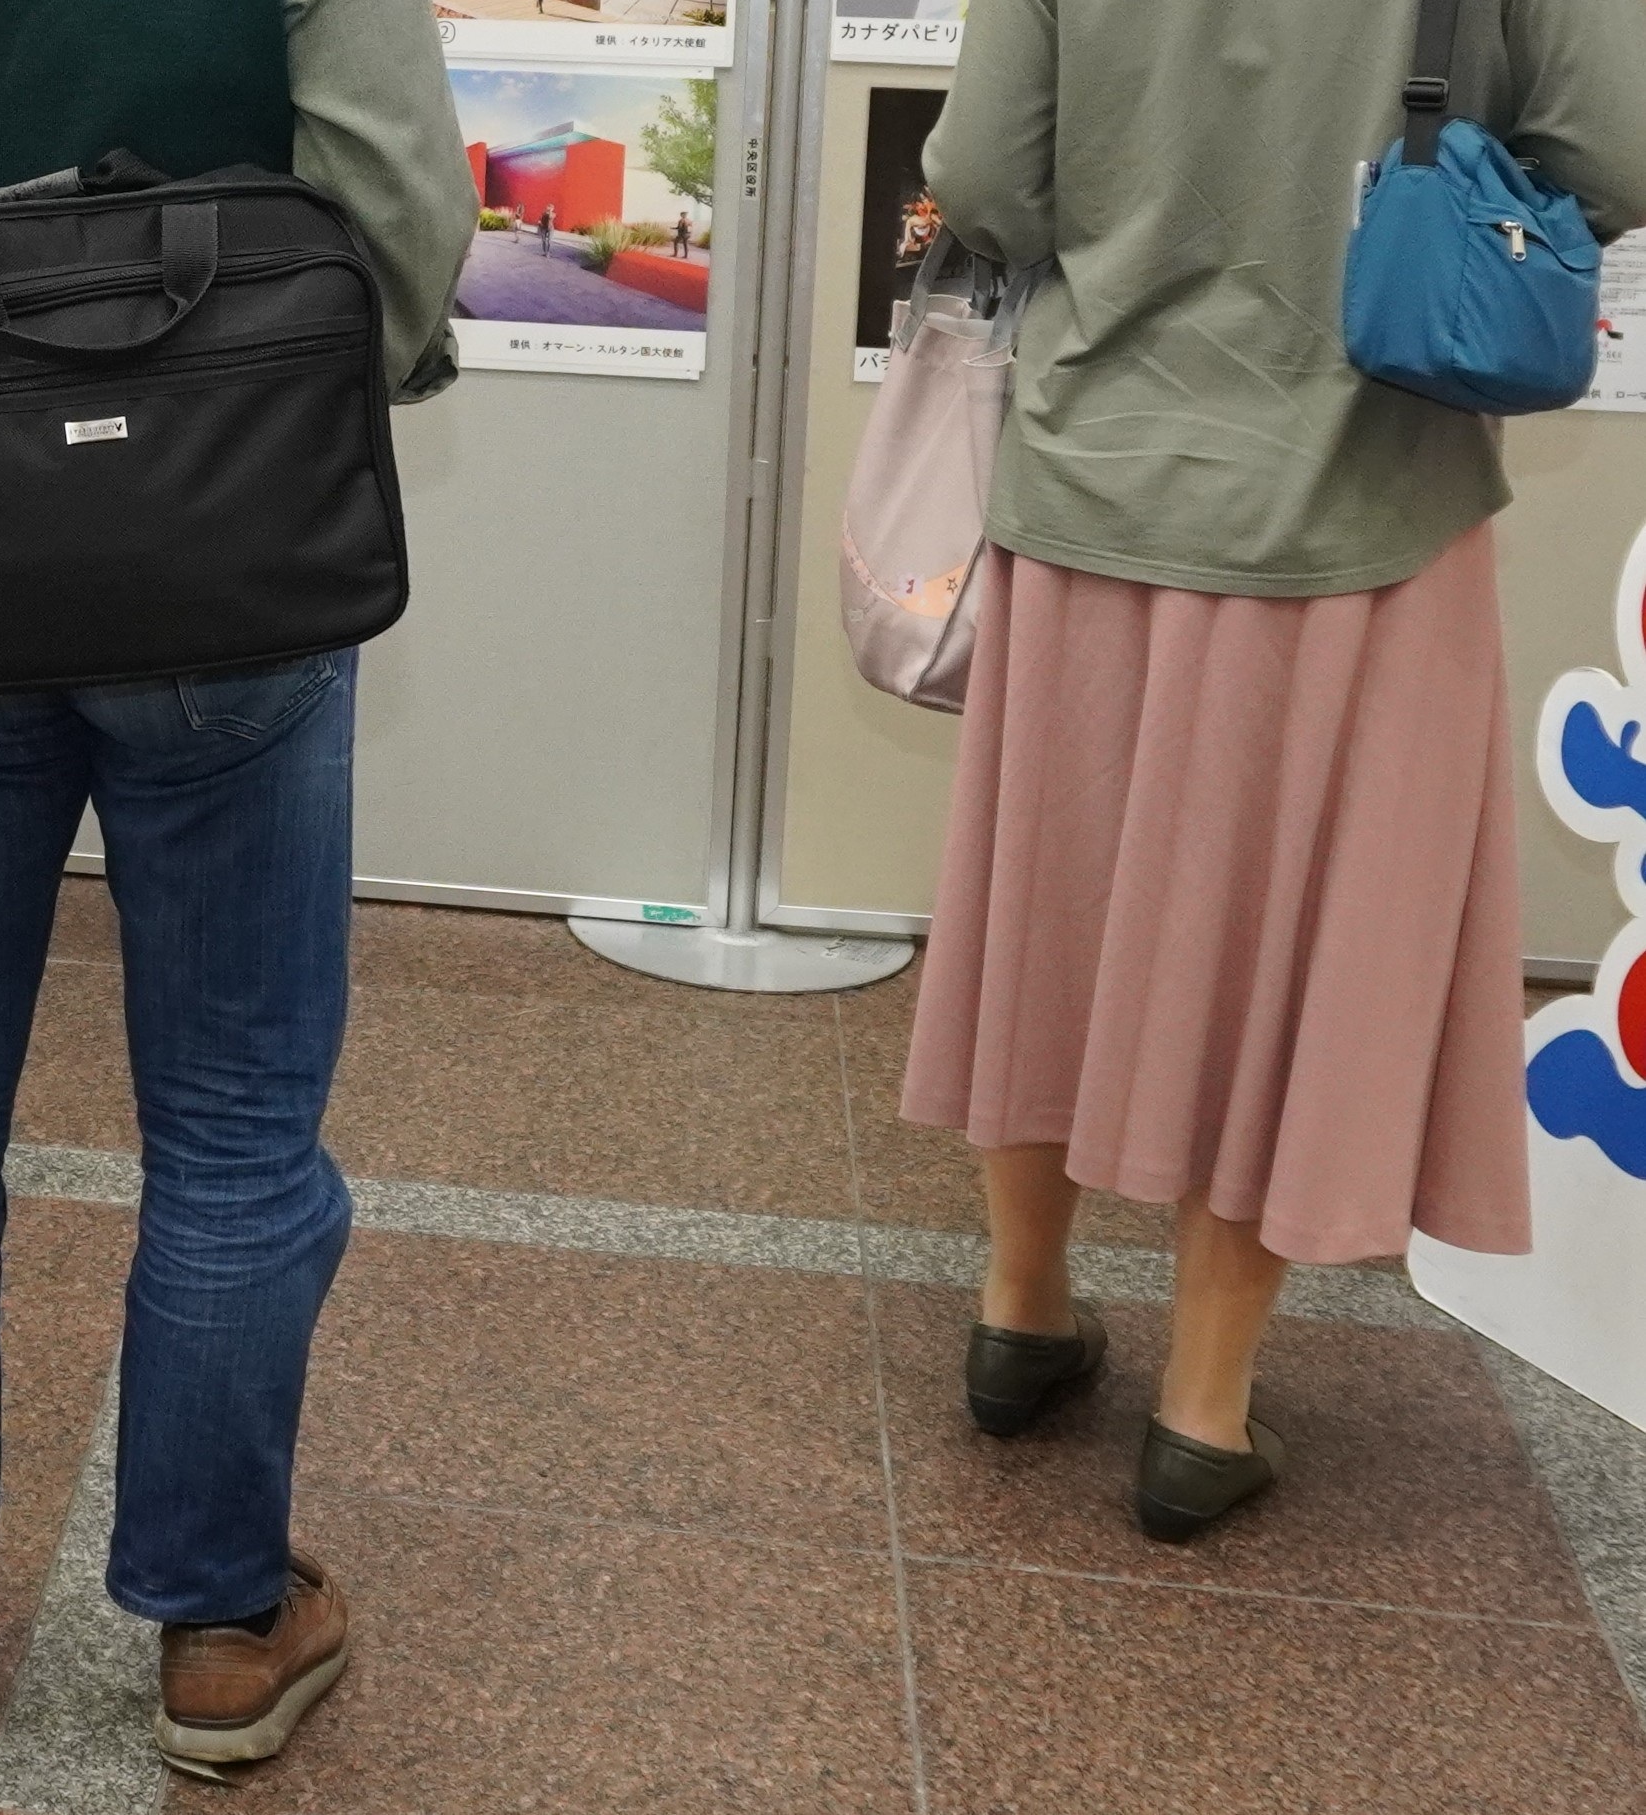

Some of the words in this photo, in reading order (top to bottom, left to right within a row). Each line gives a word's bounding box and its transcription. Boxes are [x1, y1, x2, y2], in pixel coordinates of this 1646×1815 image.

[745, 137, 759, 198] 中央区役所
